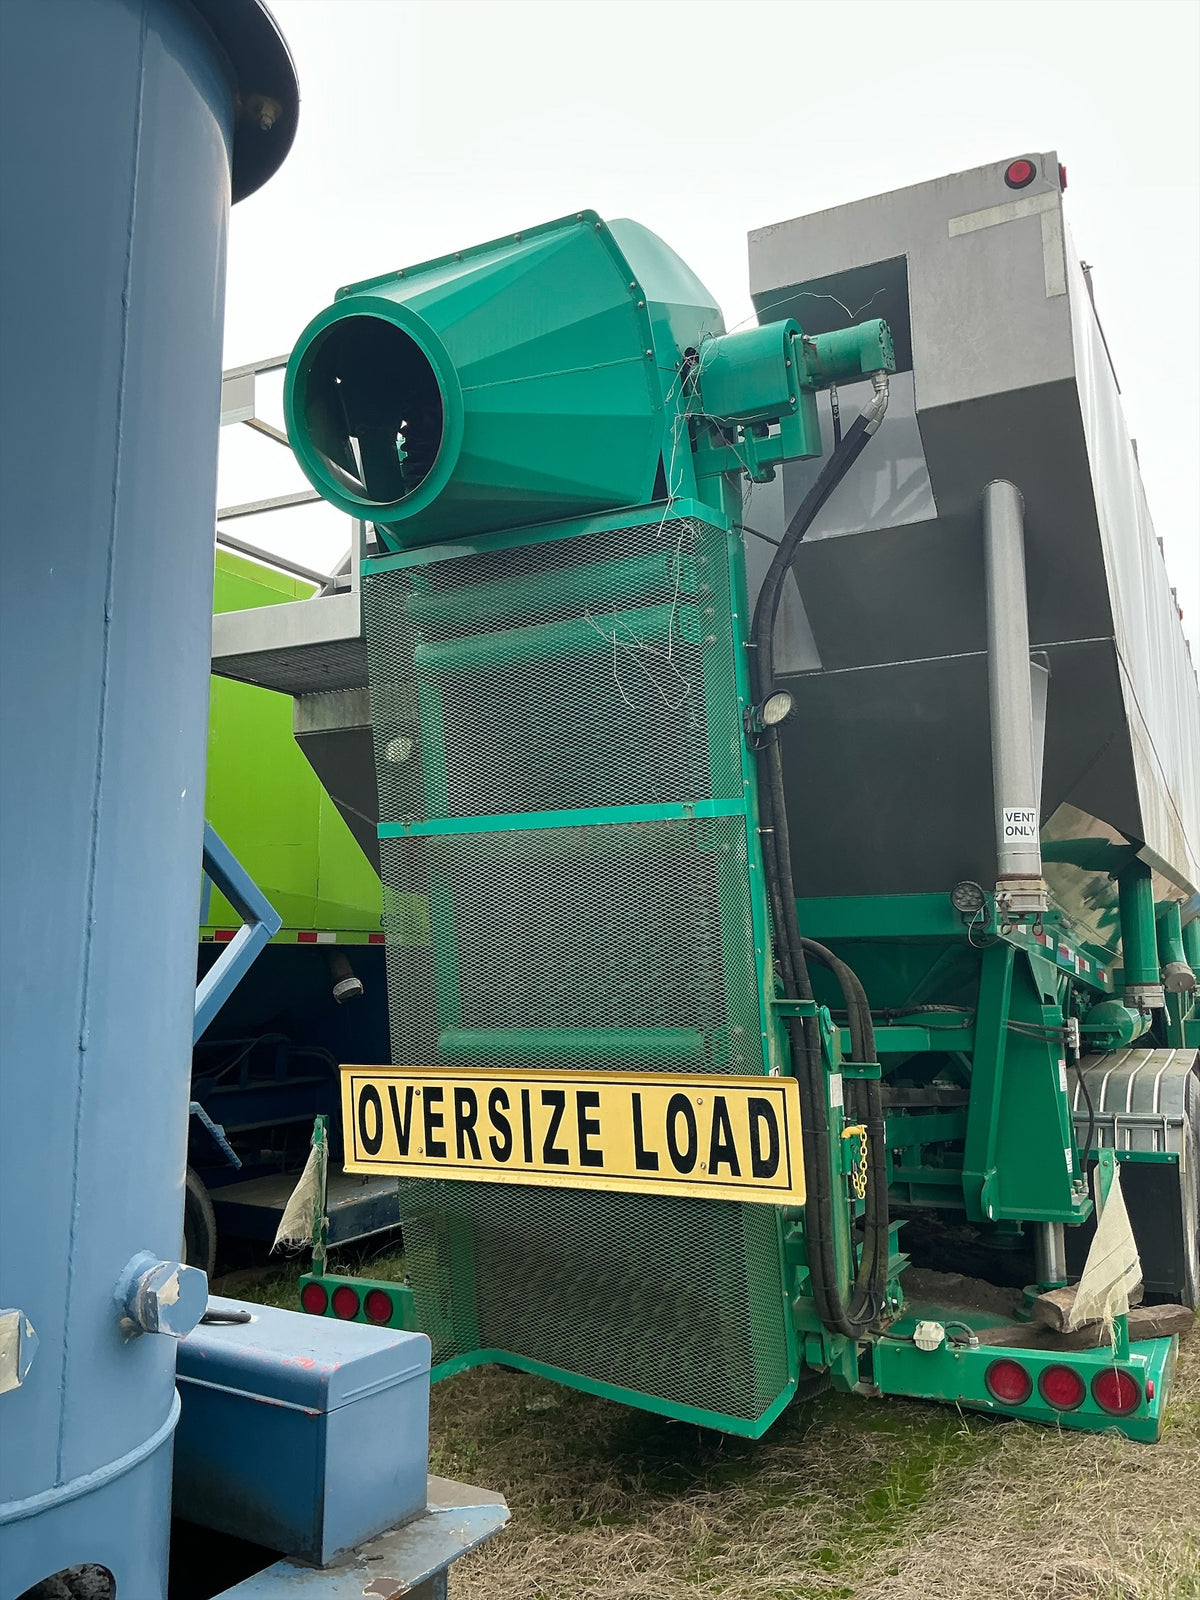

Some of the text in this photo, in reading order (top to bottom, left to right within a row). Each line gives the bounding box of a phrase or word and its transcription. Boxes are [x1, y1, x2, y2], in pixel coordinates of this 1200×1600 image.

[1005, 812, 1035, 822] VENT
[1005, 826, 1035, 836] ONLY
[358, 1083, 780, 1179] OVERSIZE LOAD
